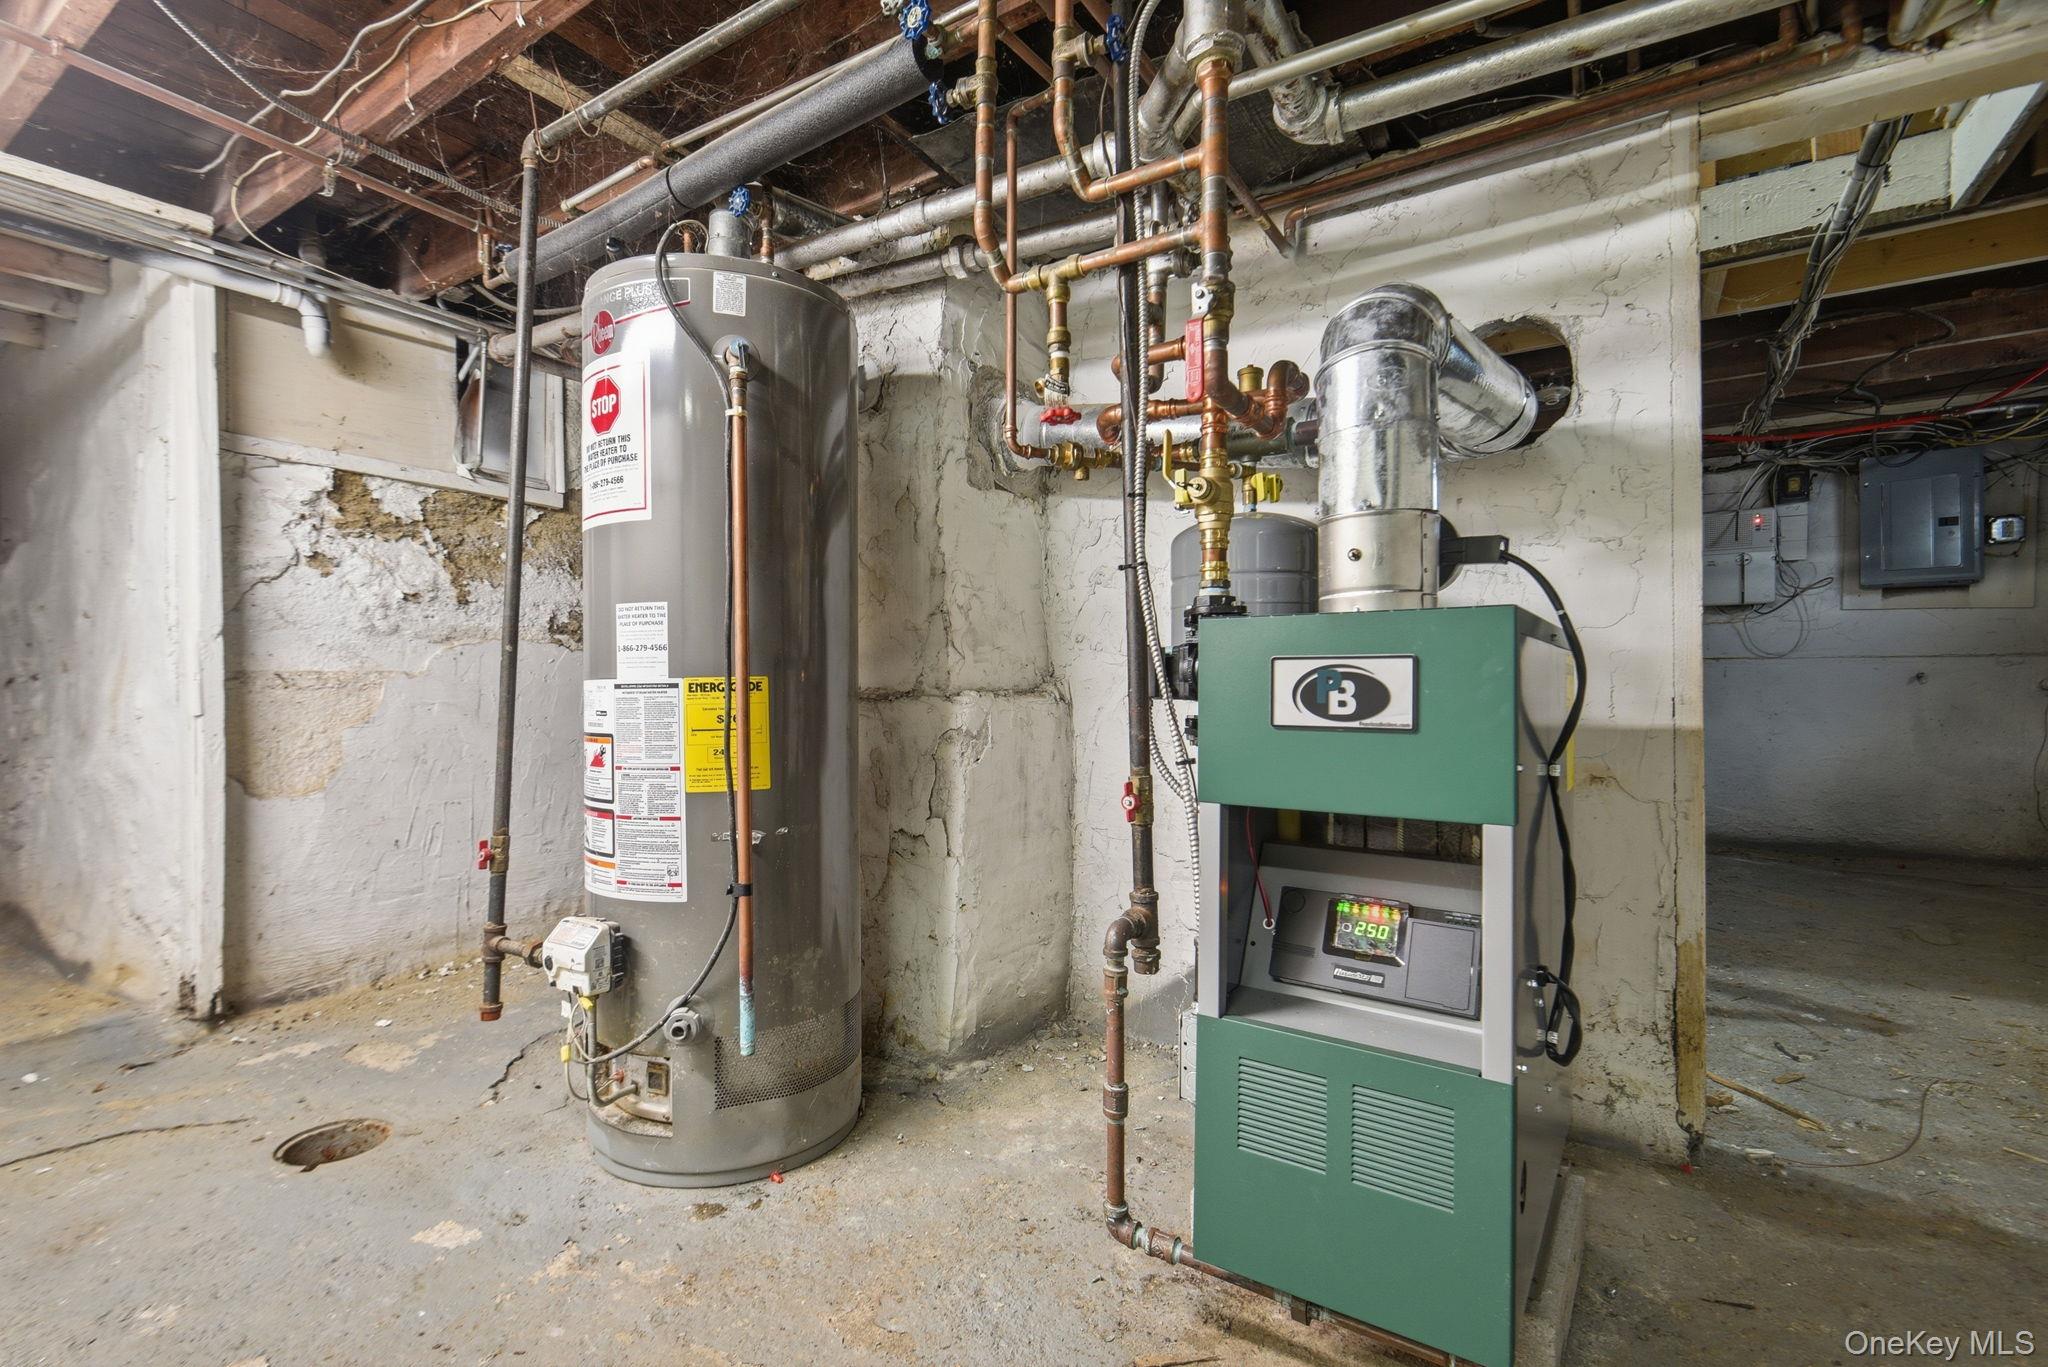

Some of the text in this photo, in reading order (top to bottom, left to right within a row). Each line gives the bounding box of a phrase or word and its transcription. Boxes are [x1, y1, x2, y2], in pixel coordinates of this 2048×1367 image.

[591, 394, 617, 419] STOP
[618, 434, 631, 442] THIS
[619, 444, 627, 453] TO
[608, 452, 638, 465] PURCHASE
[618, 644, 668, 652] 1-866-279-4566
[1354, 921, 1390, 940] 250
